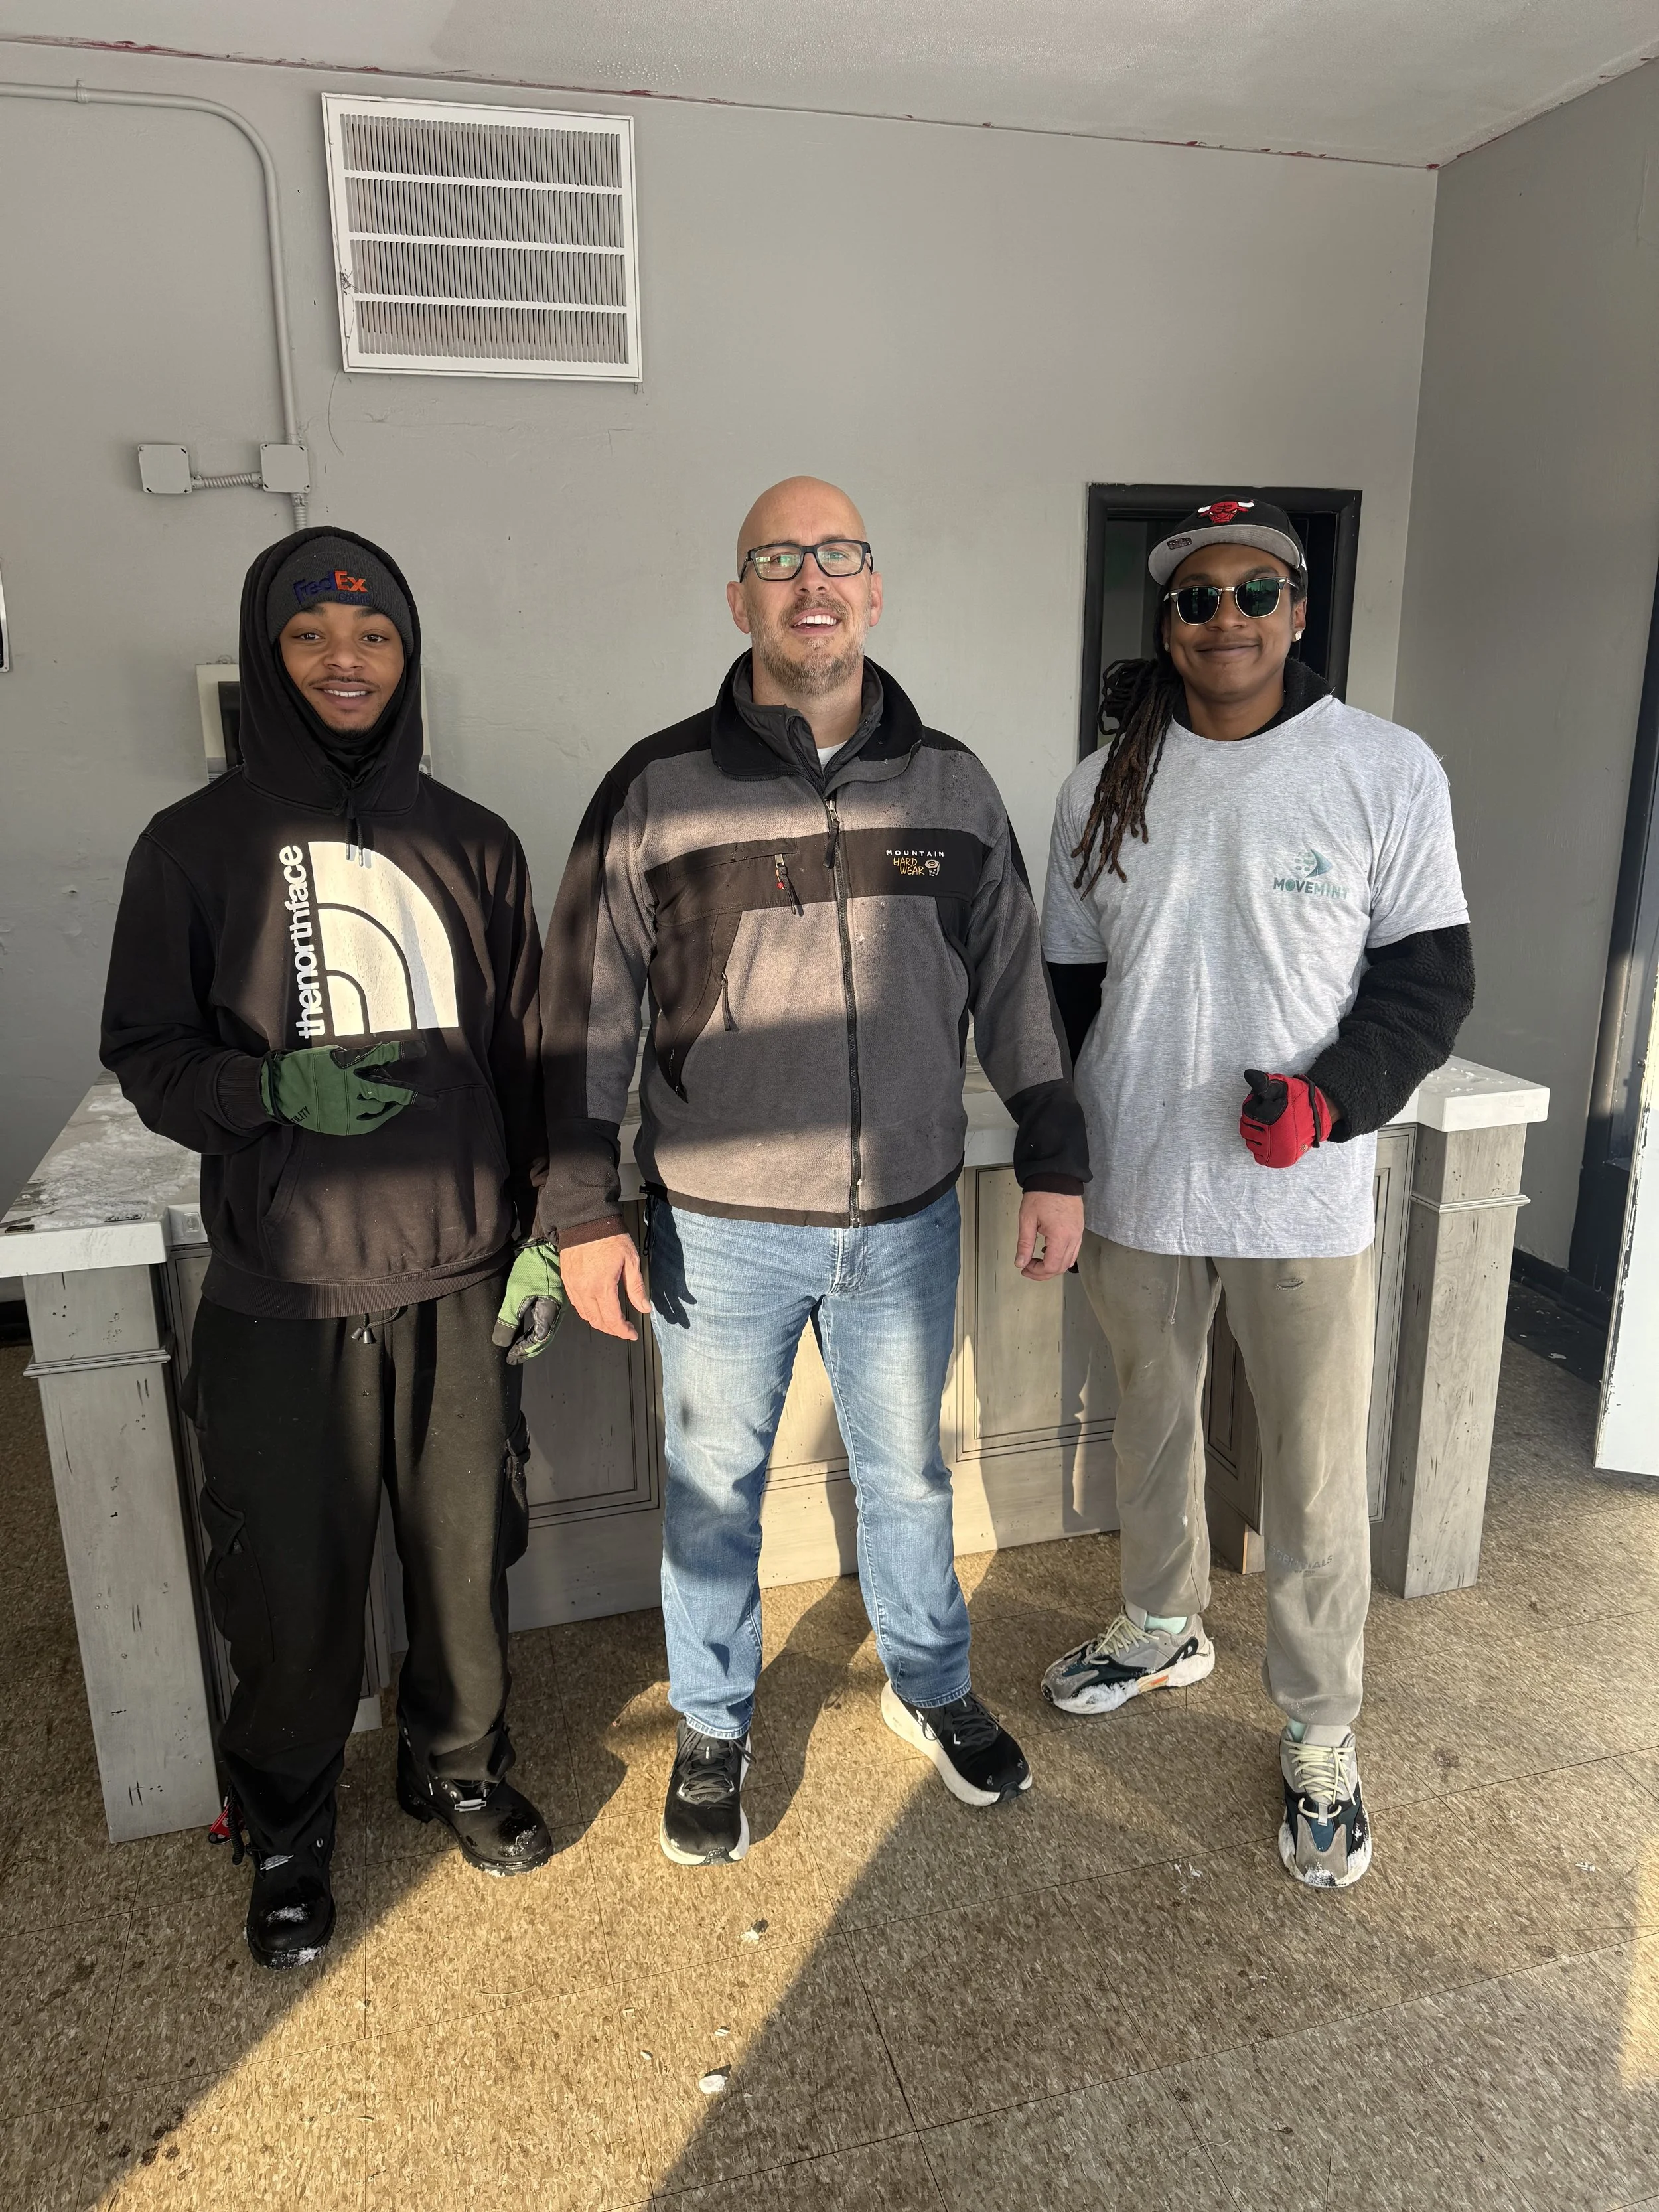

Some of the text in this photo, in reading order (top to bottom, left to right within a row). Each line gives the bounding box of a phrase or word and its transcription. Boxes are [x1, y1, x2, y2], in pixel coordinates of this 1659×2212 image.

[293, 570, 368, 604] FedEx
[893, 857, 918, 867] HARD
[899, 865, 925, 875] WEAR
[1273, 877, 1349, 899] MOVEMINT
[291, 1106, 311, 1124] TILITY
